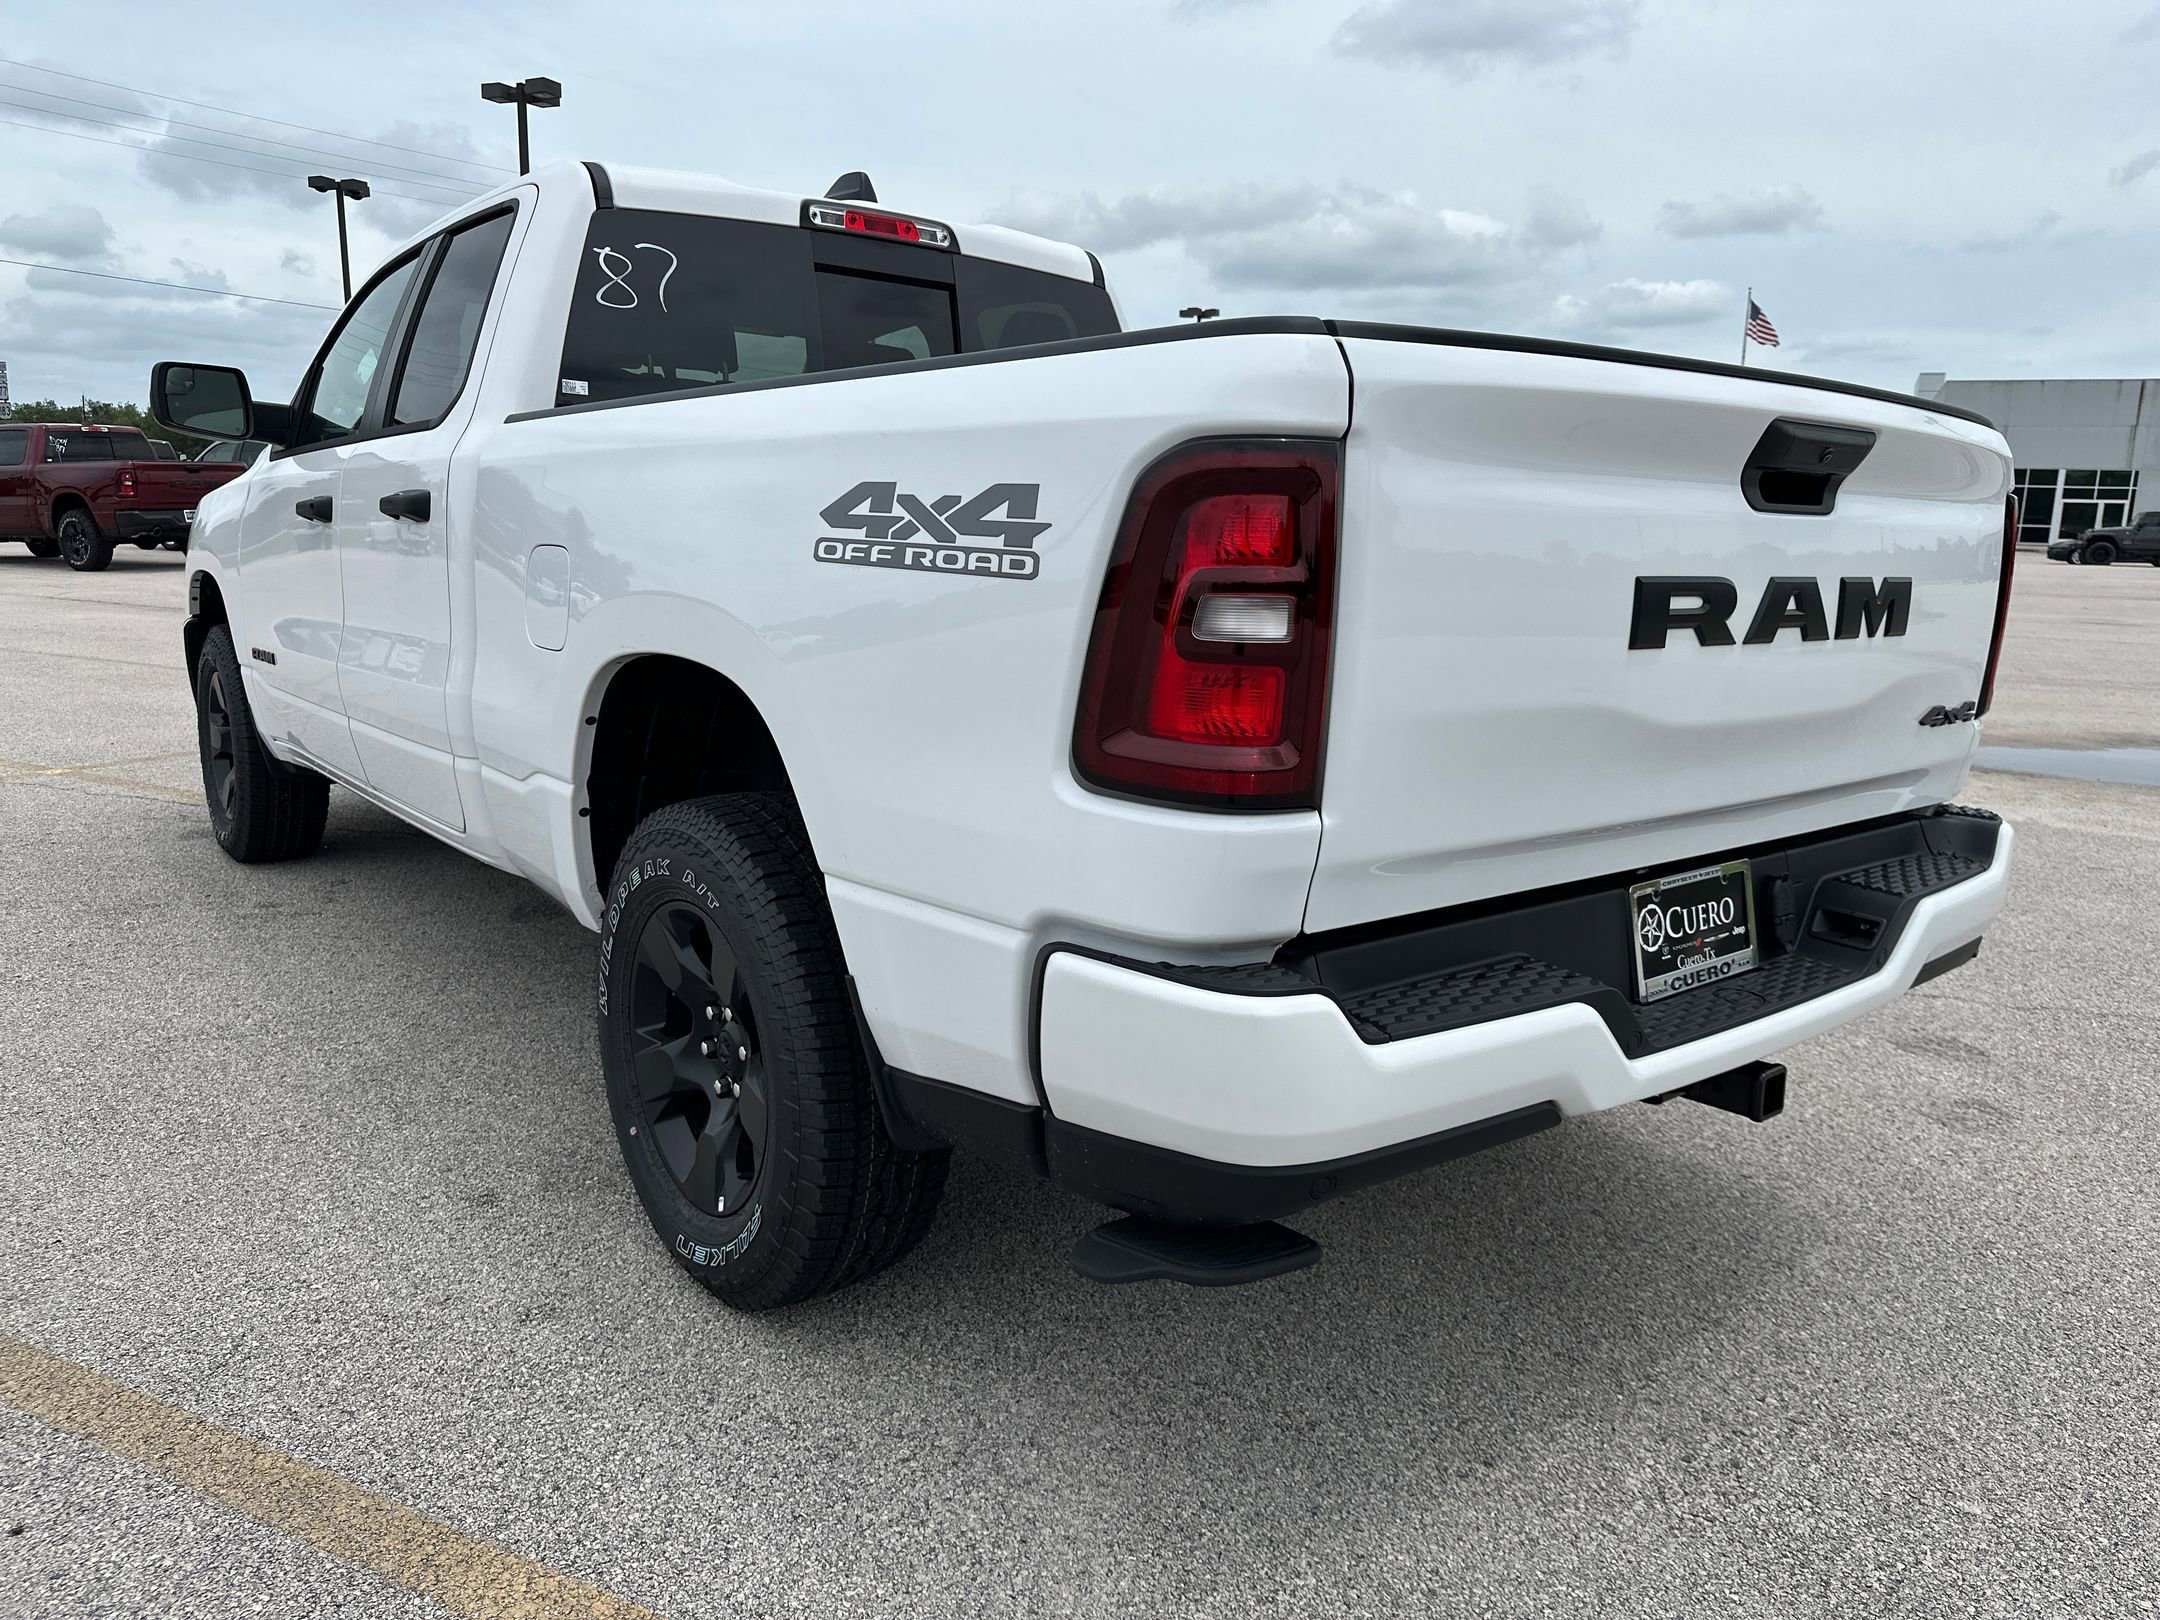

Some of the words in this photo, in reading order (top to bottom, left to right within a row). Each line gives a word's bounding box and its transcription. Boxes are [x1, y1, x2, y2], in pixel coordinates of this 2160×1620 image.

[592, 243, 678, 313] 87
[816, 540, 897, 563] OFF
[903, 546, 1035, 575] ROAD
[1628, 575, 1913, 650] RAM
[598, 858, 671, 1016] WILDPEAK
[1665, 896, 1735, 938] CUERO
[1670, 961, 1732, 991] CUERO
[675, 1203, 763, 1267] FALKEN
